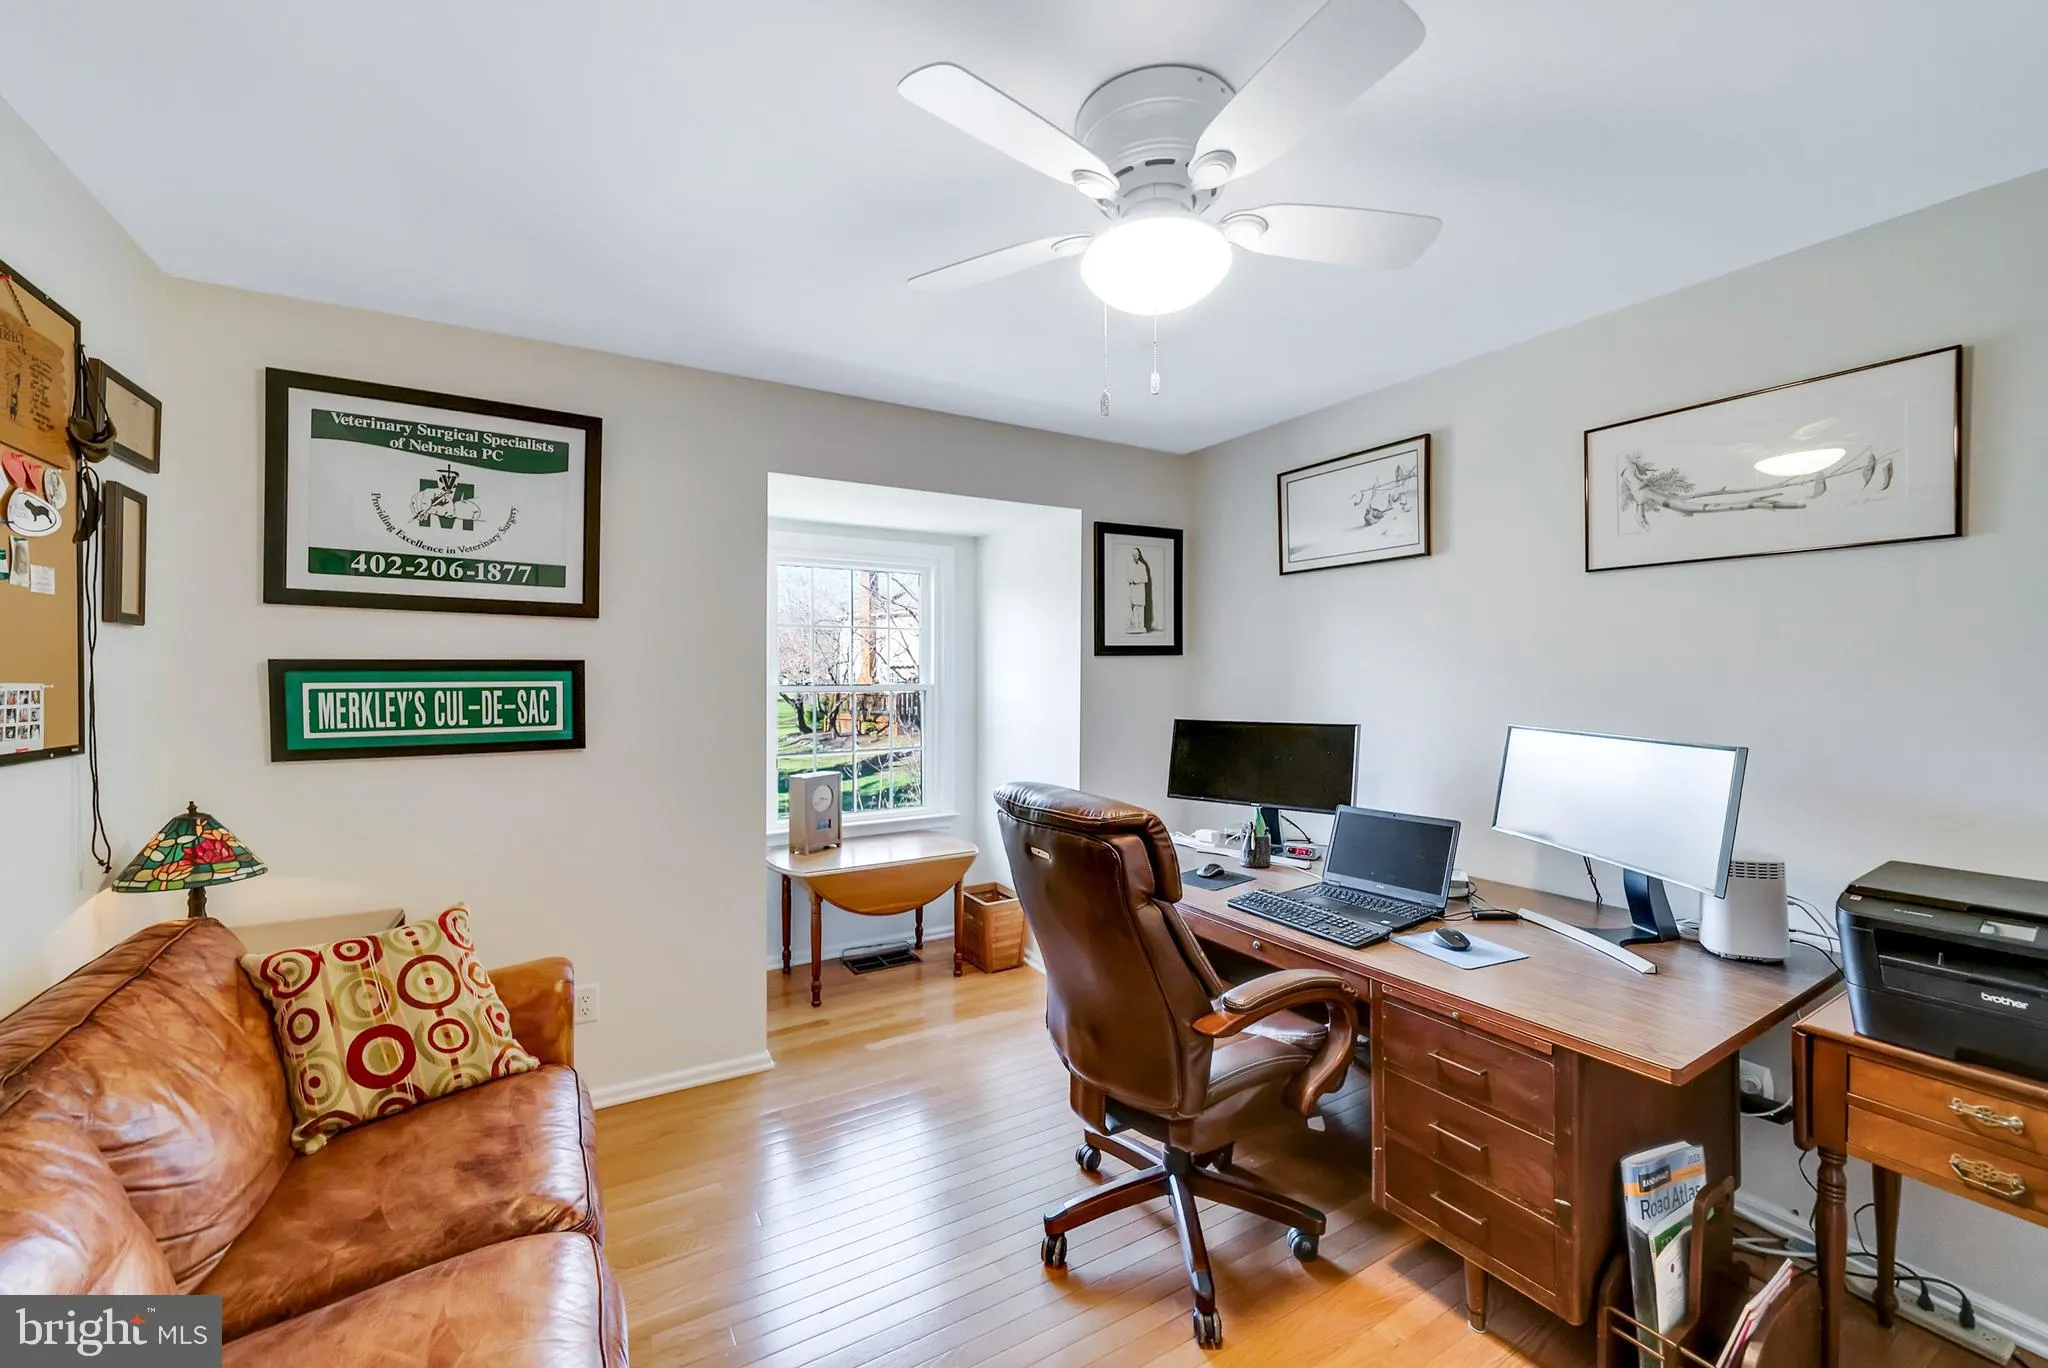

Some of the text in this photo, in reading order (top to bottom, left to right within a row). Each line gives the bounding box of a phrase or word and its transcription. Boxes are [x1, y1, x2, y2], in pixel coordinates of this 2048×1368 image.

[330, 412, 555, 453] Veterinary Surgical Specialists
[389, 438, 504, 462] of Nebraska PC
[371, 492, 519, 555] Providing Excellence in Veterinary Surgery
[350, 554, 533, 584] 402-206-1877
[317, 688, 550, 730] MERKLEY'S CUL-DE-SAC
[1981, 991, 2029, 1009] brother
[1640, 1196, 1670, 1220] Road
